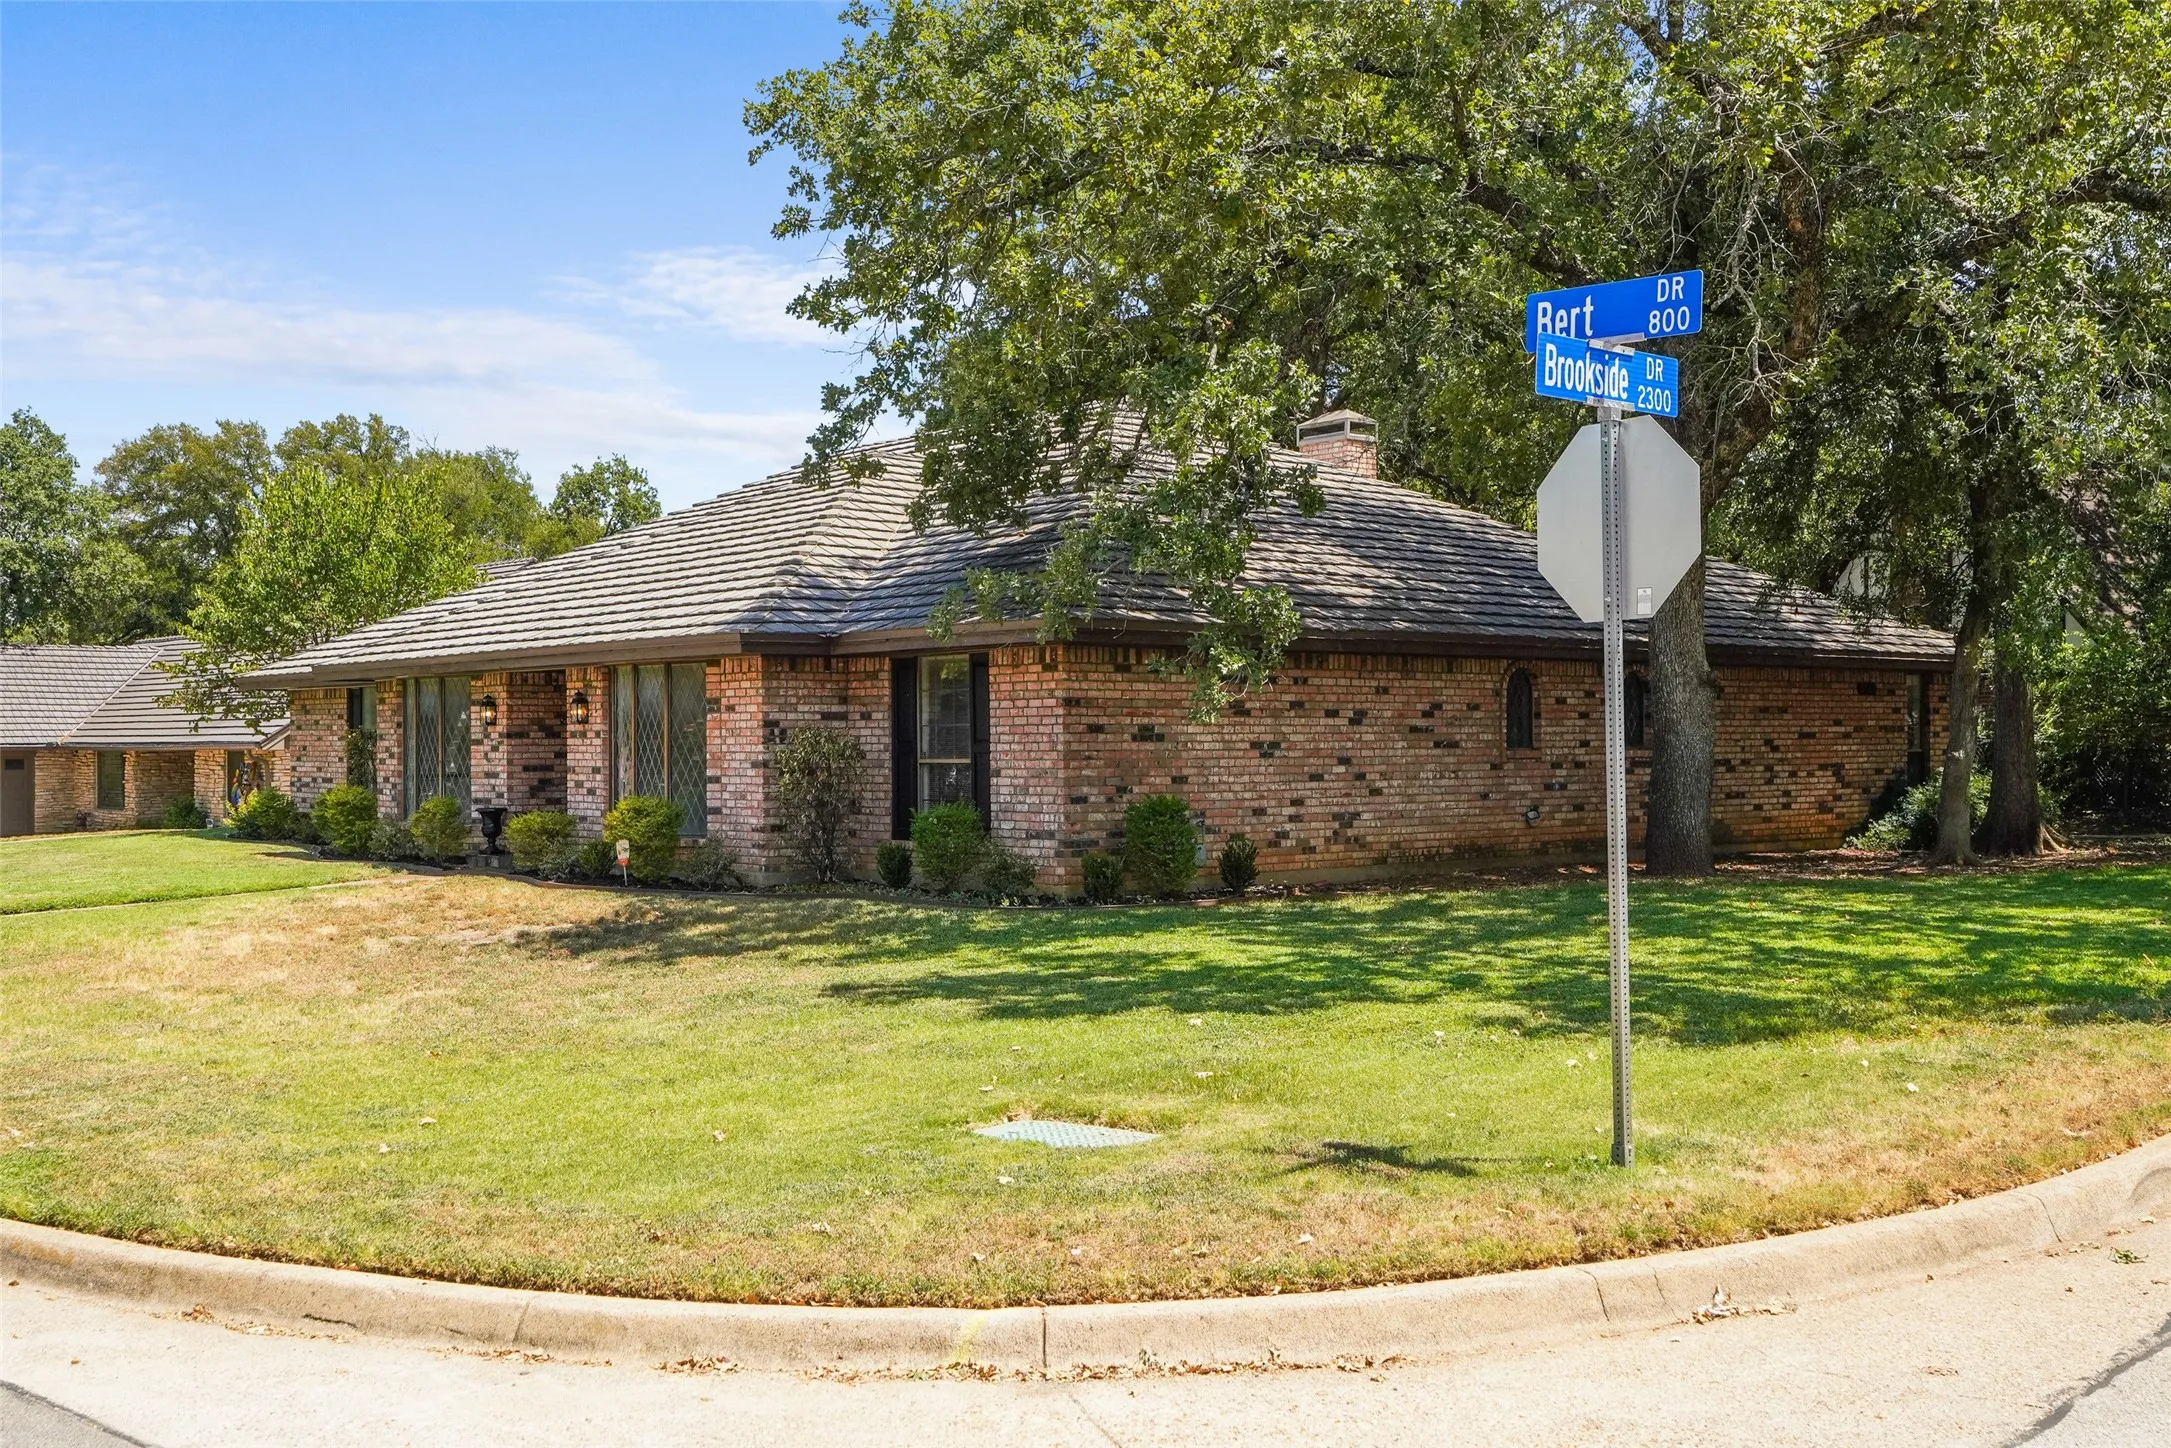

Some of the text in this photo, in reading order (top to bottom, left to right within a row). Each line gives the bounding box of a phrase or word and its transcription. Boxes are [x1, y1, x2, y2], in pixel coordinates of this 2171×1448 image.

[1657, 276, 1685, 302] DR
[1537, 295, 1594, 338] Bert
[1648, 306, 1690, 334] 800
[1545, 343, 1629, 399] Brookside
[1646, 357, 1663, 382] DR
[1637, 385, 1671, 412] 2300
